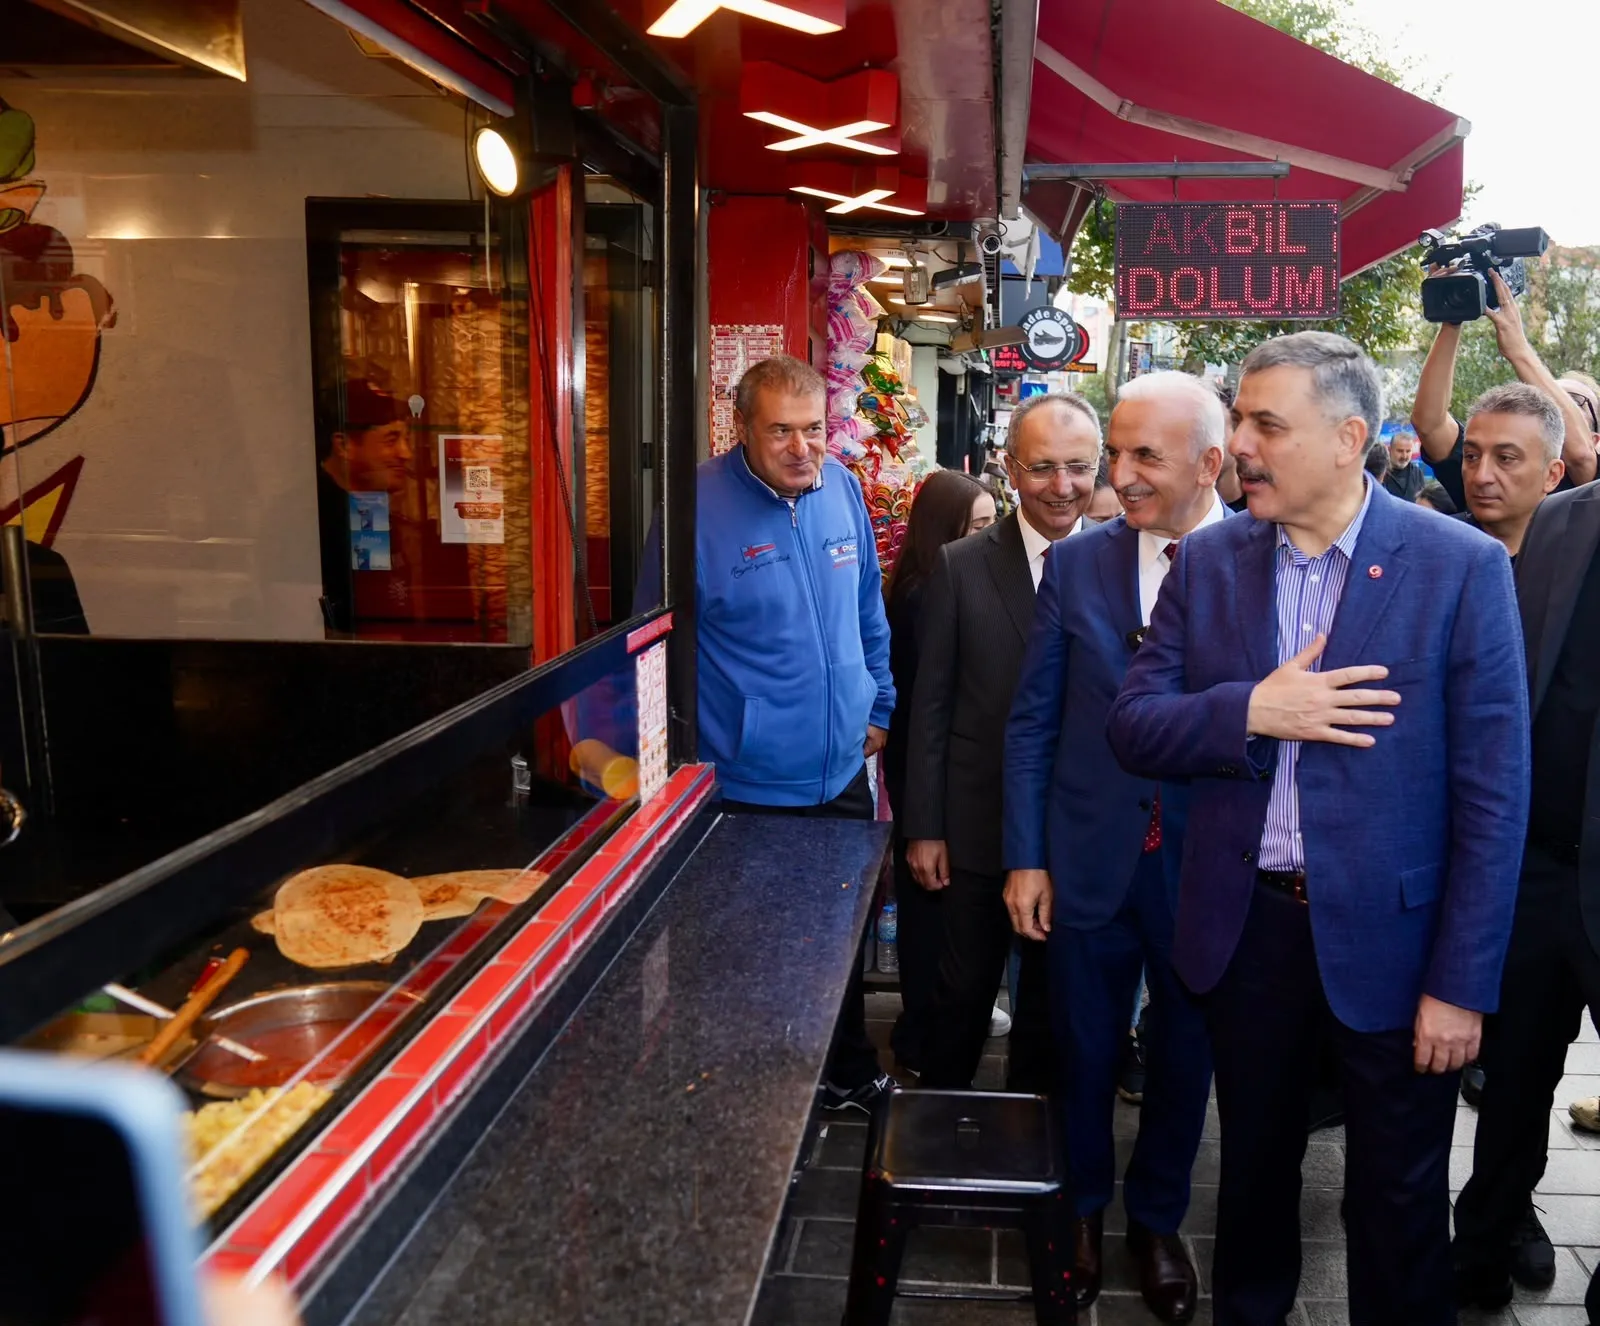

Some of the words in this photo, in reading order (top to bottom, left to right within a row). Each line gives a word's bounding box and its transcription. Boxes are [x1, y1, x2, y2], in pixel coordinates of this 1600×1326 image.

[1129, 265, 1323, 309] DOLUM
[1022, 309, 1050, 335] adde
[1053, 311, 1075, 339] Spor
